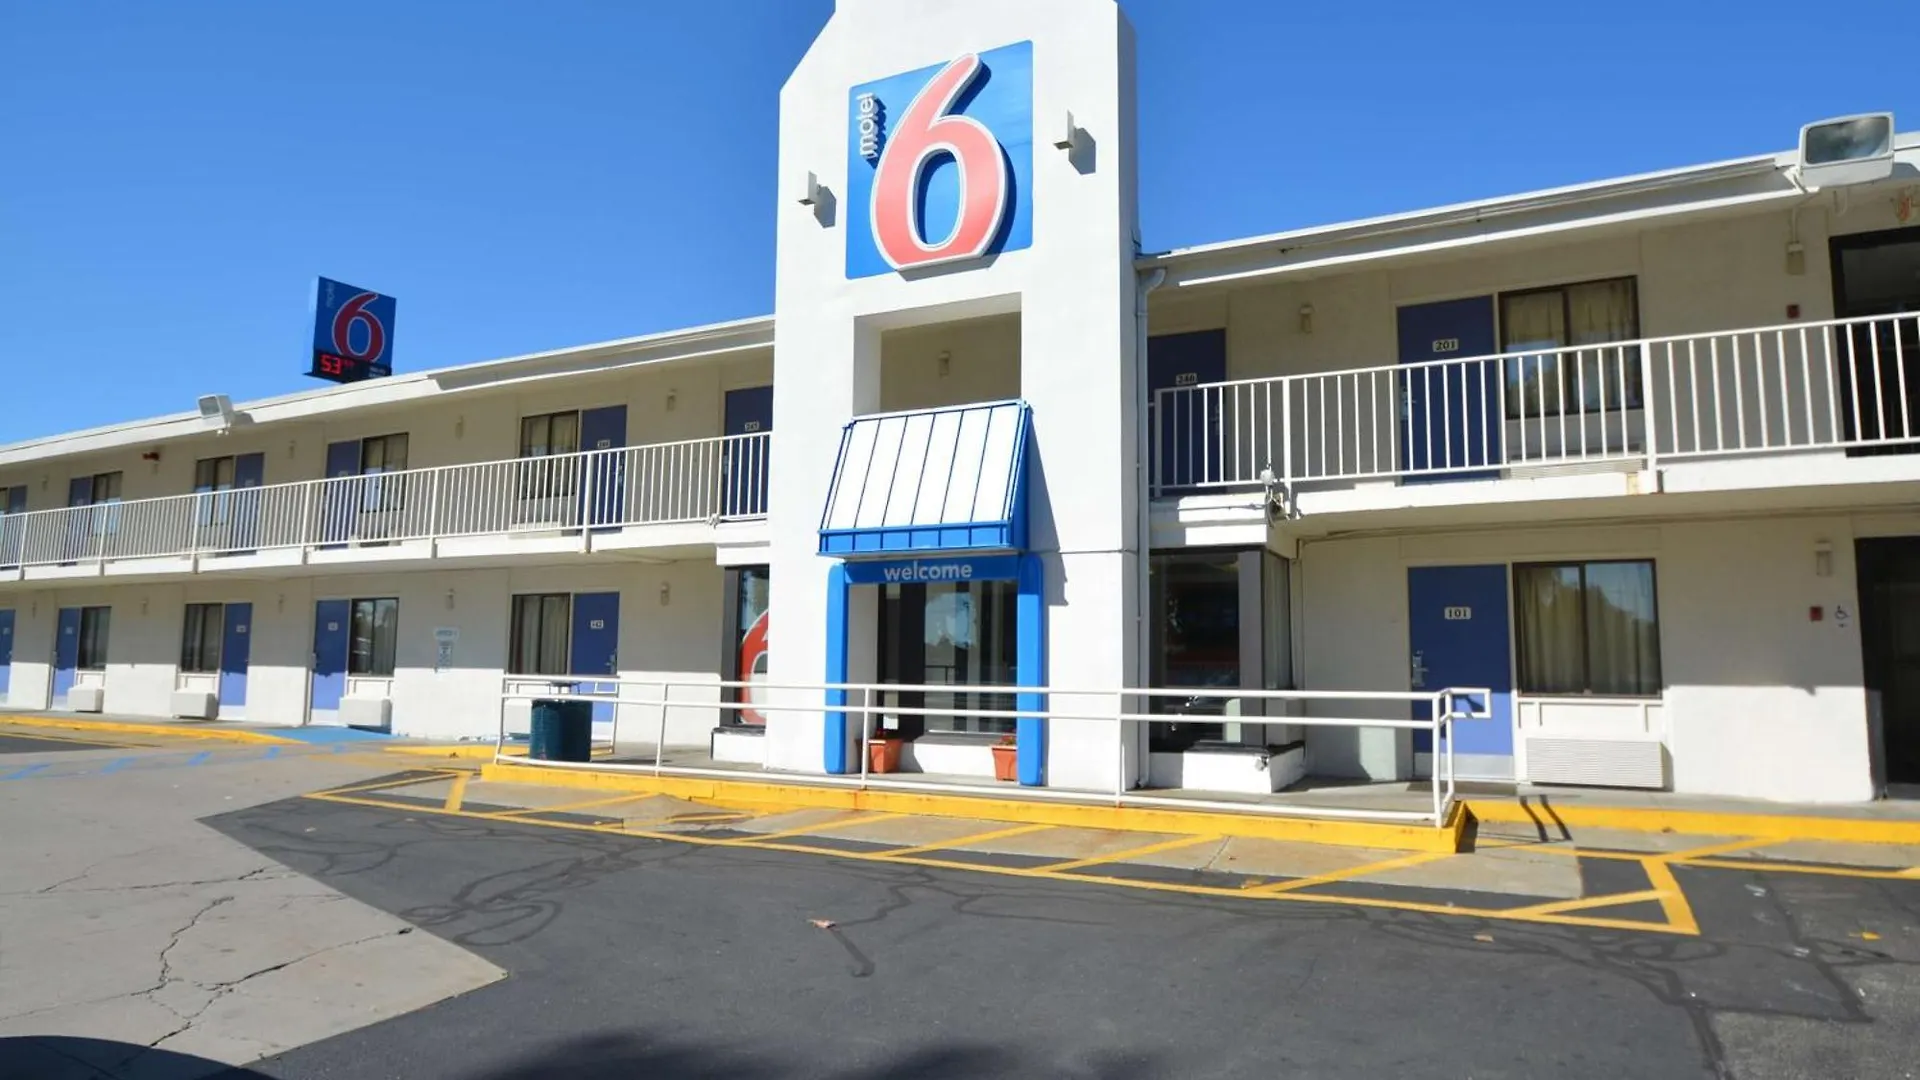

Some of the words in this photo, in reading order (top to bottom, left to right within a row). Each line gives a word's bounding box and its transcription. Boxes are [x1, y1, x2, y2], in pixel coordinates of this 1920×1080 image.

[856, 92, 878, 158] motel
[869, 53, 1009, 271] 6
[331, 291, 386, 363] 6
[1434, 340, 1457, 351] 201
[883, 560, 973, 581] welcome
[1446, 607, 1469, 619] 101
